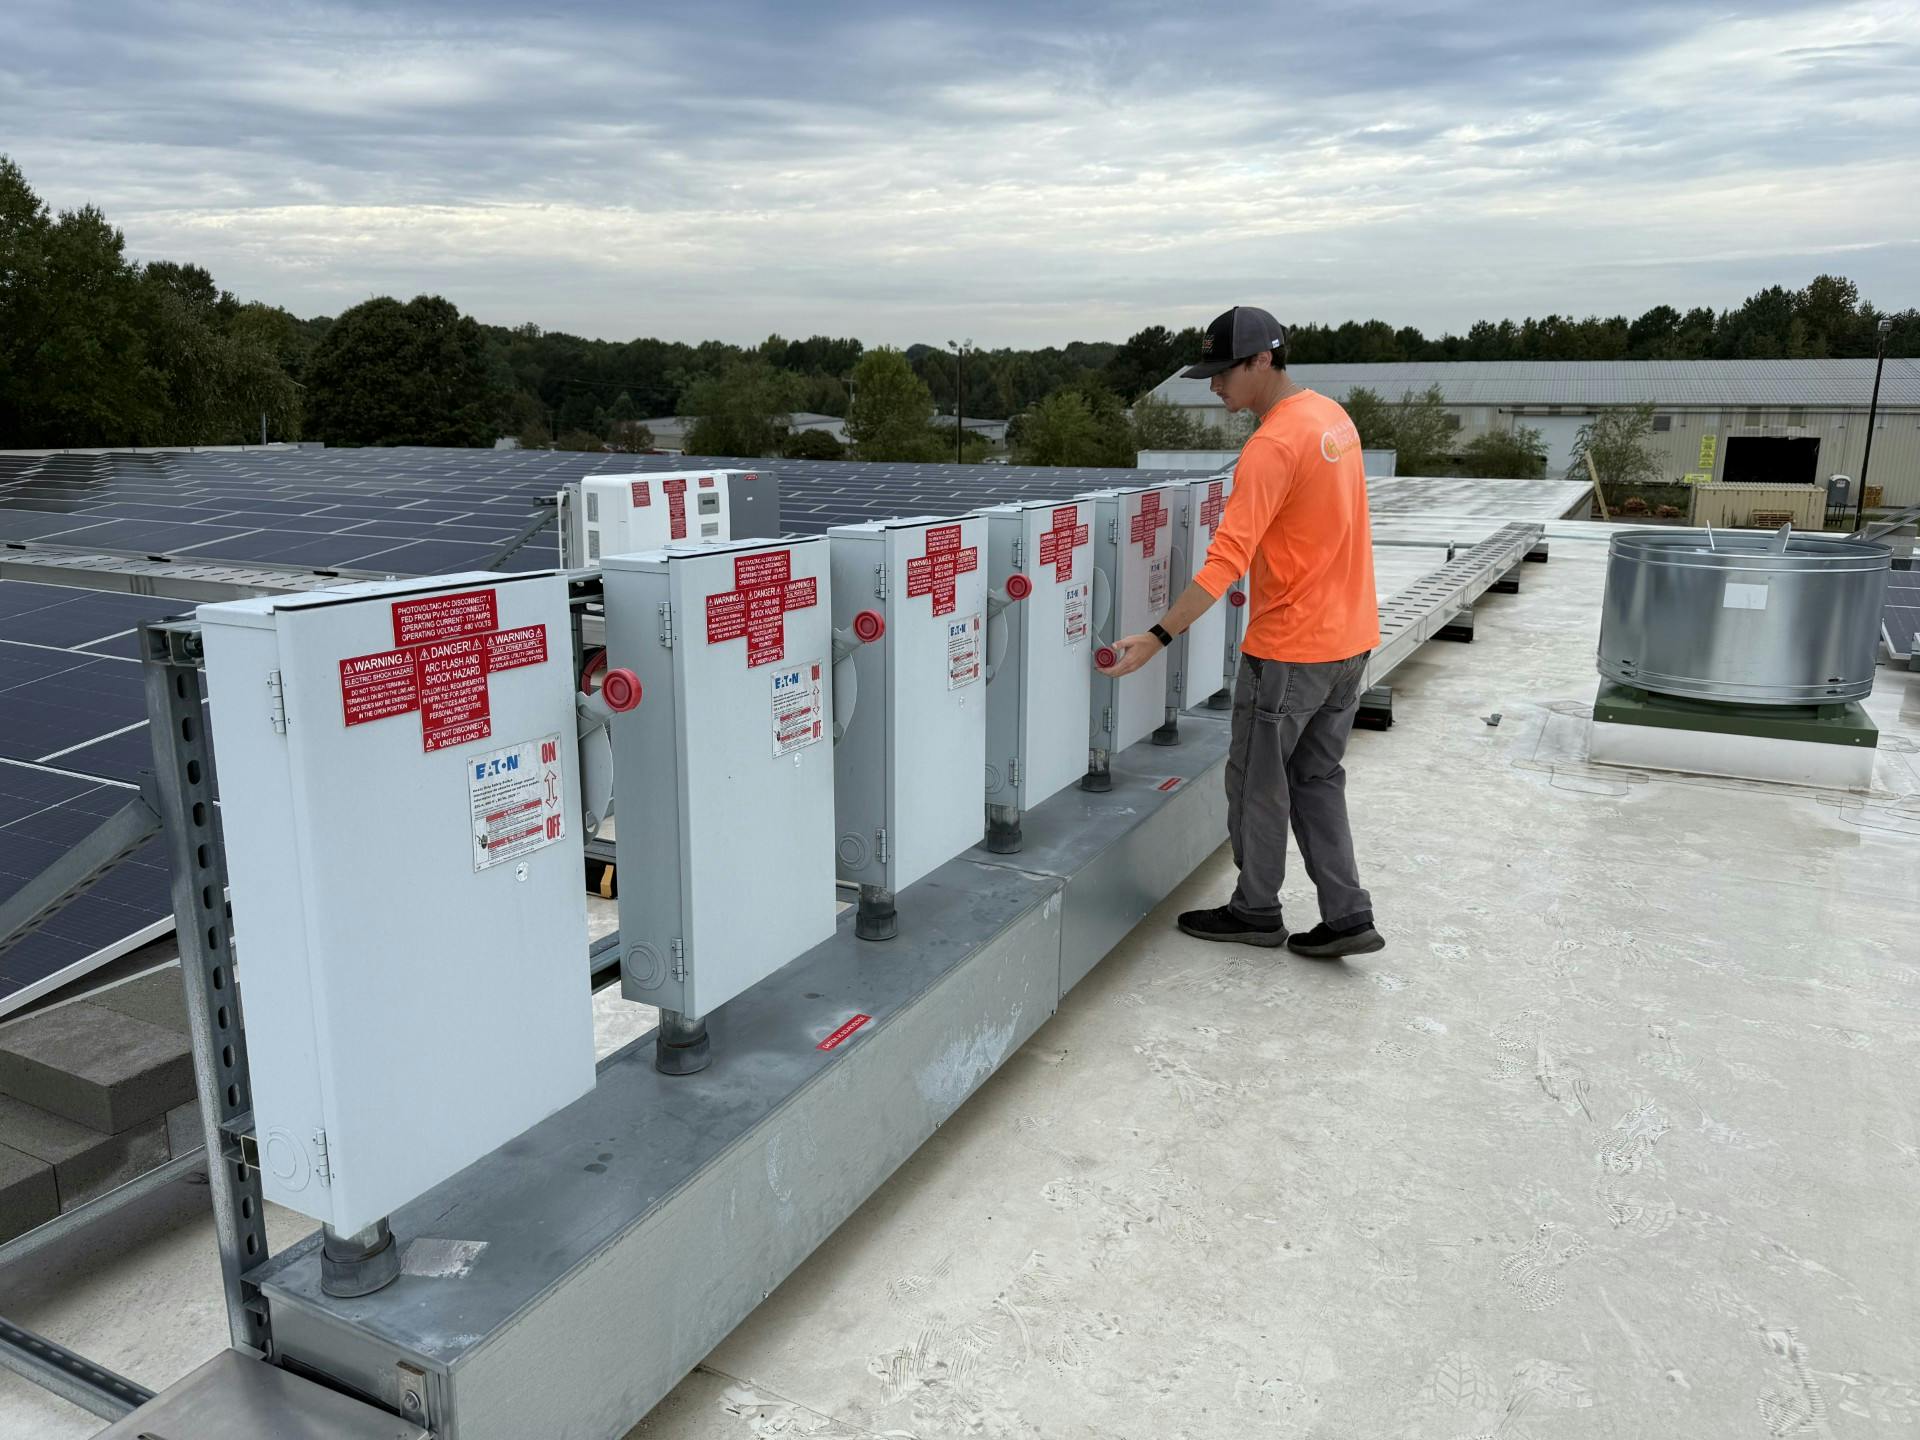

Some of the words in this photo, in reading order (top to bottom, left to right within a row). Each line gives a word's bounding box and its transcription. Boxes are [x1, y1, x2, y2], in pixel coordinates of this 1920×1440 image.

[398, 603, 442, 615] PHOTOVOLTAIC
[452, 596, 486, 607] DISCONNECT
[401, 616, 413, 624] FED
[414, 613, 431, 622] FROM
[450, 604, 485, 616] DISCONNECT
[402, 621, 435, 632] OPERATING
[436, 616, 464, 627] CURRENT:
[476, 612, 490, 620] AMPS
[402, 630, 436, 642] OPERATING
[437, 625, 463, 635] VOLTAGE:
[475, 620, 492, 629] VOLTS
[496, 630, 535, 644] WARNING
[431, 641, 471, 658] DANGER!
[354, 654, 402, 672] WARNING
[425, 662, 440, 674] ARC
[442, 657, 464, 670] FLASH
[465, 654, 480, 666] AND
[345, 676, 372, 686] ELECTRIC
[373, 672, 392, 680] SHOCK
[393, 667, 414, 676] HAZARD
[426, 671, 451, 686] SHOCK
[453, 665, 481, 680] HAZARD
[369, 684, 386, 692] TOUCH
[422, 686, 441, 697] FOLLOW
[450, 677, 484, 690] REQUIREMENTS
[460, 688, 471, 696] SAFE
[472, 685, 485, 694] WORK
[348, 706, 361, 714] LOAD
[387, 704, 408, 713] POSITION
[429, 708, 452, 720] PERSONAL
[454, 702, 481, 714] PROTECTIVE
[432, 699, 457, 711] PRACTICES
[442, 729, 452, 738] NOT
[453, 722, 484, 735] DISCONNECT
[440, 736, 461, 747] UNDER
[463, 732, 479, 741] LOAD
[542, 741, 556, 764] ON
[476, 754, 518, 780] EATON
[546, 814, 561, 840] OFF
